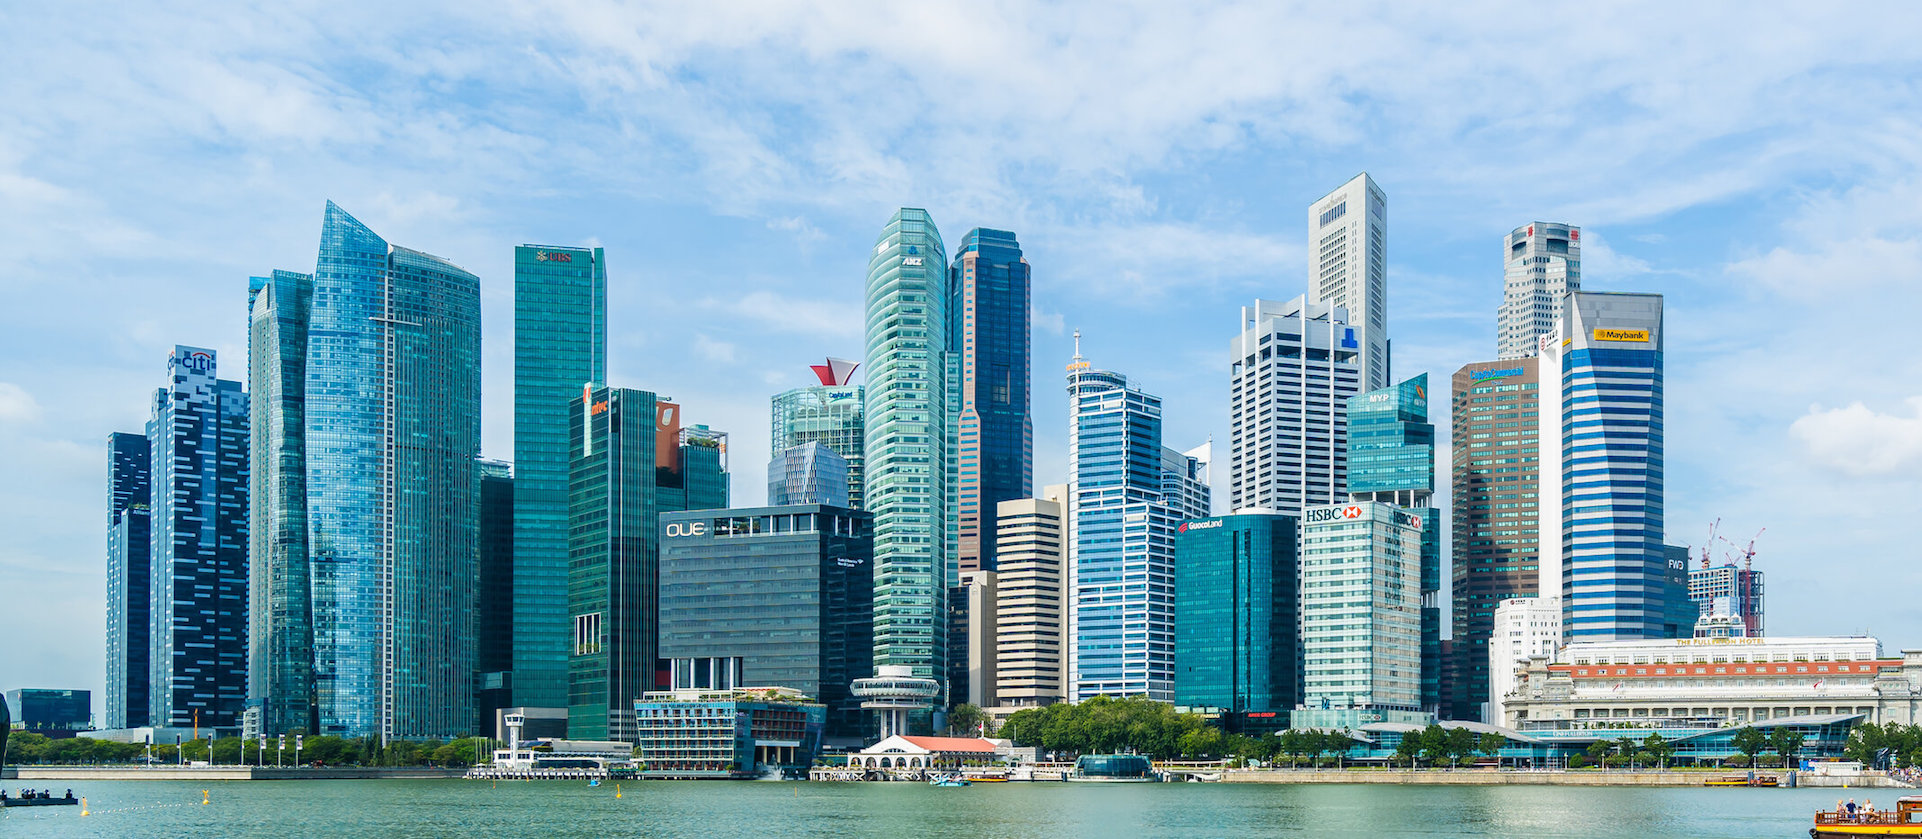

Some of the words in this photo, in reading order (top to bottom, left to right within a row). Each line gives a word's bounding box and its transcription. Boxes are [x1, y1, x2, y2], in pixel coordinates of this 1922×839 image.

[549, 252, 572, 263] UBS
[902, 258, 922, 266] ANZ
[1606, 331, 1644, 340] Maybank
[1306, 507, 1342, 522] HSBC
[1393, 510, 1411, 526] HSBC
[666, 522, 705, 538] OUE
[1189, 519, 1223, 530] GuocoLand
[1668, 559, 1684, 570] FWD
